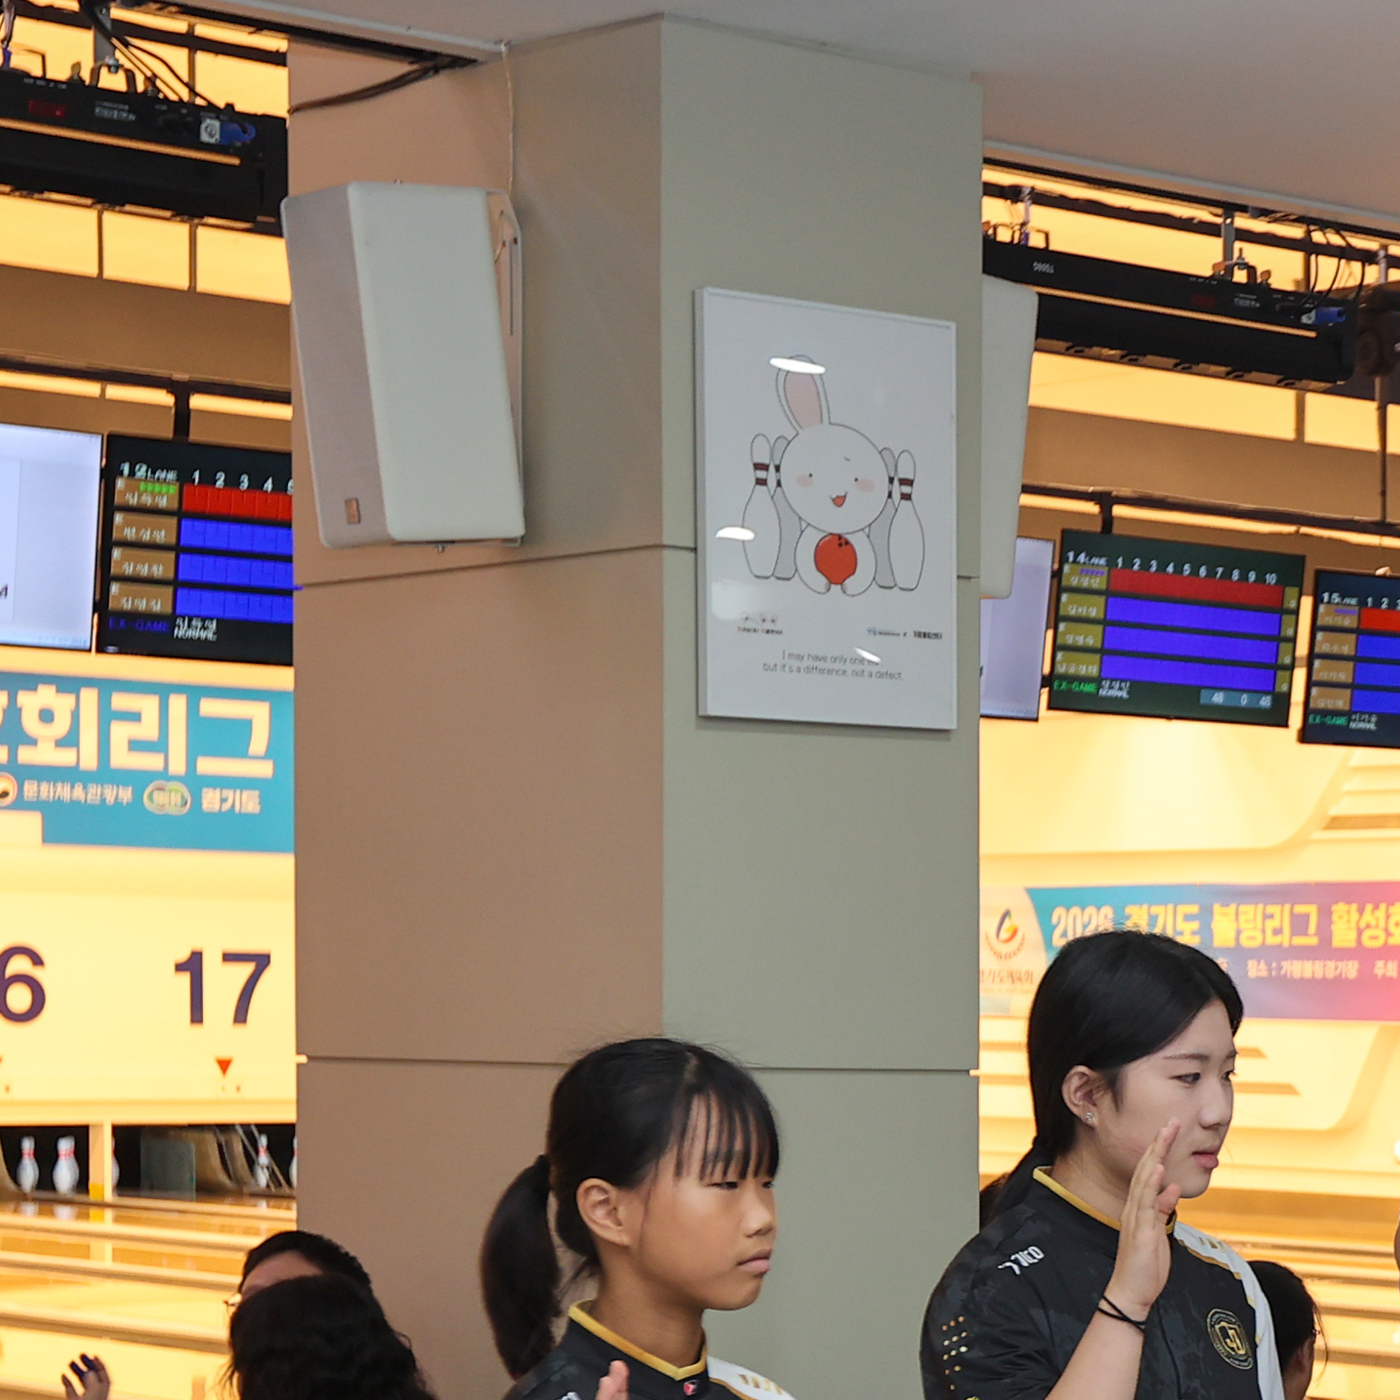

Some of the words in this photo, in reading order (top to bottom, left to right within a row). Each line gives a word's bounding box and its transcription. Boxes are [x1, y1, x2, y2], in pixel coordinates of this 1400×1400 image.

[215, 471, 226, 489] 2
[239, 473, 250, 491] 3
[262, 476, 273, 494] 4
[1117, 556, 1124, 568] 1
[1132, 558, 1141, 570] 2
[1149, 560, 1158, 572] 3
[1166, 562, 1175, 574] 4
[1182, 563, 1191, 576] 5
[1199, 565, 1208, 577] 6
[1215, 567, 1225, 579] 7
[1231, 569, 1240, 581] 8
[1248, 570, 1257, 582] 9
[1264, 572, 1278, 585] 10
[1366, 596, 1373, 607] 1
[1381, 597, 1389, 609] 2
[763, 662, 777, 672] but
[851, 668, 865, 678] not
[787, 651, 803, 663] may
[807, 652, 828, 663] have
[830, 654, 845, 666] only
[0, 683, 274, 779] 회리그
[23, 779, 134, 806] 문화체육관광부
[201, 787, 261, 815] 경기도
[1211, 902, 1319, 948] 볼링리그
[1247, 959, 1268, 978] 장소
[1280, 960, 1358, 979] 가평볼링경기장
[1373, 960, 1398, 978] 주최
[174, 950, 271, 1024] 17
